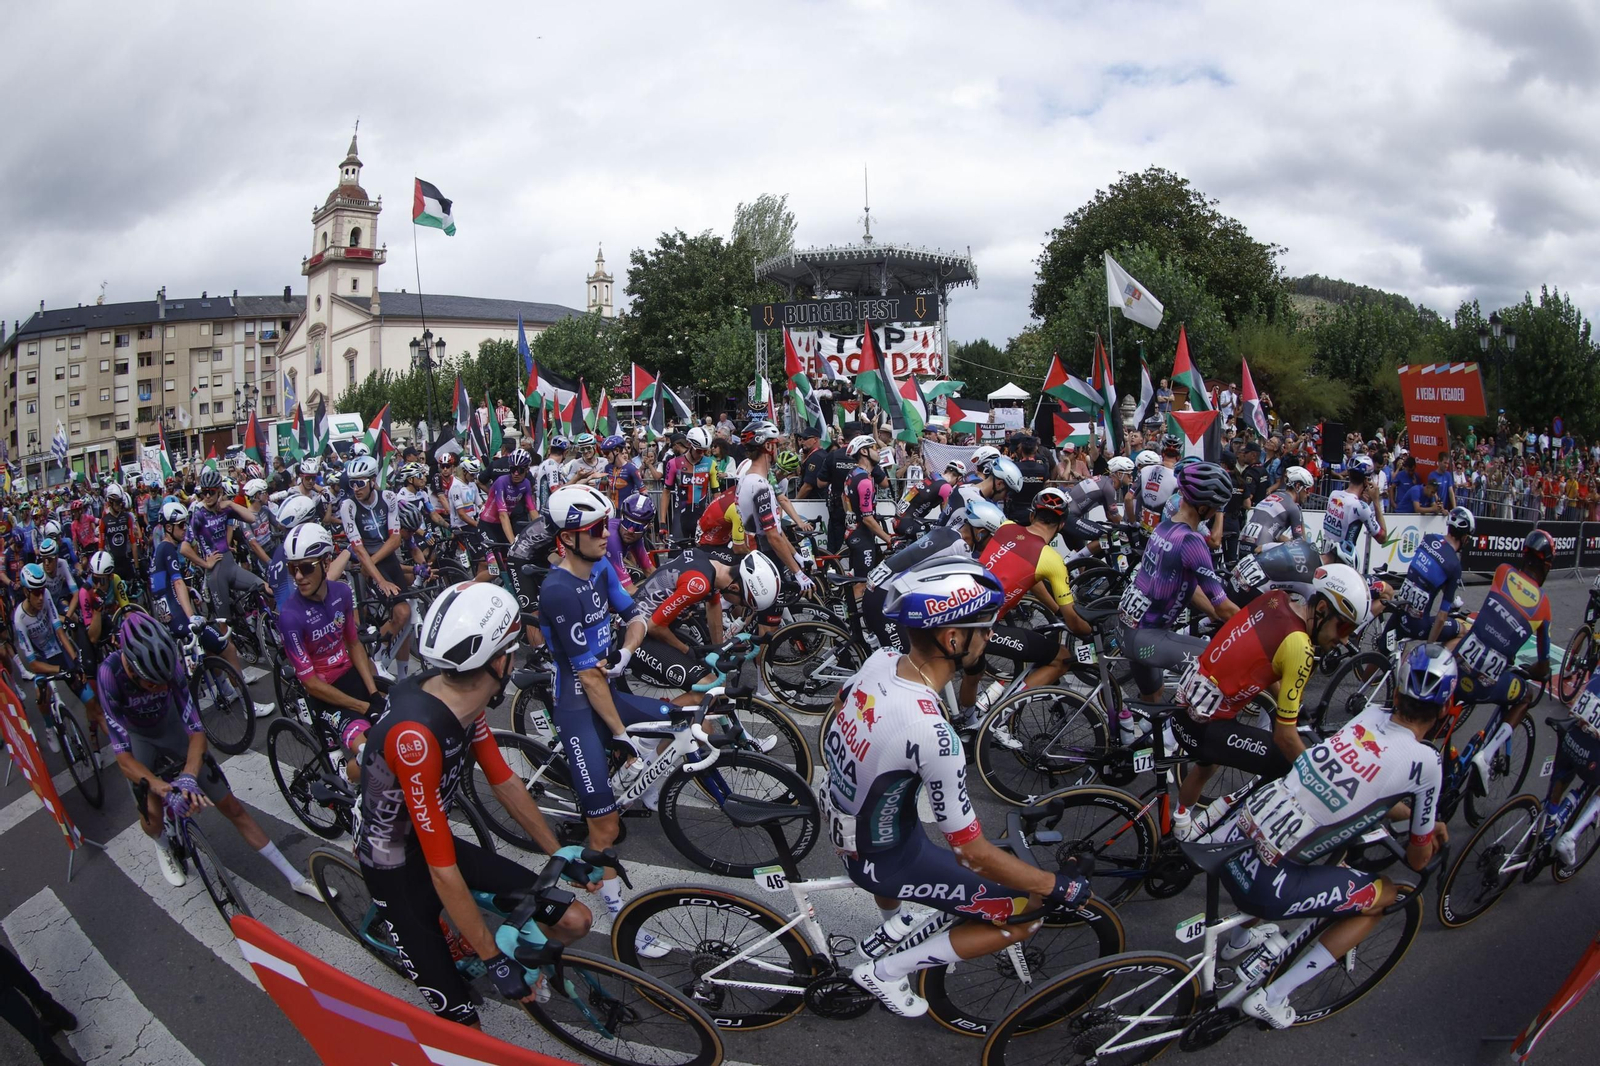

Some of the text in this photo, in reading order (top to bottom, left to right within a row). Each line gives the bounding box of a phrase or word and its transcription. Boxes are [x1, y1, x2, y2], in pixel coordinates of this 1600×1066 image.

[785, 299, 899, 325] BURGER FEST
[798, 352, 944, 379] GEOCDIO
[1416, 388, 1420, 400] A
[1420, 387, 1435, 400] VEIGA
[1440, 387, 1465, 401] VEGADEO
[1420, 415, 1440, 423] TISSOT
[1414, 434, 1419, 444] LA
[1420, 435, 1437, 446] VUELTA
[682, 475, 706, 485] lotto
[862, 488, 872, 508] lotto
[108, 524, 128, 533] ARKEA
[204, 516, 228, 528] Jayco
[1150, 528, 1173, 552] ayco
[1488, 536, 1525, 550] TISSOT
[864, 549, 873, 567] lotto
[985, 540, 1016, 571] ofidis
[510, 568, 520, 593] ARKEA
[636, 587, 674, 620] ARKEA
[662, 594, 690, 618] ARKEA
[921, 590, 991, 628] SPECIALIZED
[925, 578, 986, 616] Red Bull
[1162, 581, 1188, 624] Jayco
[1411, 590, 1428, 611] 133
[480, 606, 496, 628] ARKEA
[584, 600, 608, 624] Groupa
[1487, 597, 1527, 638] TREK
[990, 632, 1024, 652] Cofidis
[1209, 608, 1264, 664] Cofidis
[634, 647, 662, 674] ARKEA
[1076, 647, 1091, 662] 155
[1462, 640, 1482, 666] 24
[668, 672, 683, 682] B&B
[1287, 638, 1315, 702] Cofidi
[1484, 656, 1502, 679] 24
[124, 690, 168, 708] Jayco
[1188, 681, 1220, 716] 171
[534, 714, 549, 730] 137
[1170, 716, 1198, 748] Cofidis
[400, 740, 423, 754] B&B
[846, 730, 871, 762] Bull
[934, 722, 950, 757] BORA
[1226, 734, 1268, 756] Cofidis
[570, 736, 596, 794] Groupama
[826, 730, 858, 785] ORA
[1134, 756, 1152, 772] 171
[1328, 730, 1382, 783] Red Bull
[626, 749, 676, 800] Wilier
[1312, 746, 1361, 800] ORA
[410, 772, 435, 832] ARKEA
[664, 780, 683, 820] MICHE
[930, 780, 947, 823] BORA
[1420, 786, 1436, 827] BORA
[367, 788, 404, 854] ARKEA
[1270, 810, 1303, 850] 48
[1300, 808, 1387, 859] hansgrohe
[792, 818, 813, 857] MICHE
[1240, 848, 1261, 881] RA
[766, 874, 784, 890] 46
[898, 884, 966, 901] BORA
[678, 898, 762, 919] roval
[1282, 886, 1343, 916] BORA
[1186, 923, 1201, 938] 48
[385, 919, 418, 980] ARKEA
[1102, 966, 1176, 978] roval
[860, 974, 905, 1016] SPECIALIZED
[1254, 1004, 1285, 1030] SPECIALIZED
[1294, 1008, 1330, 1023] rov
